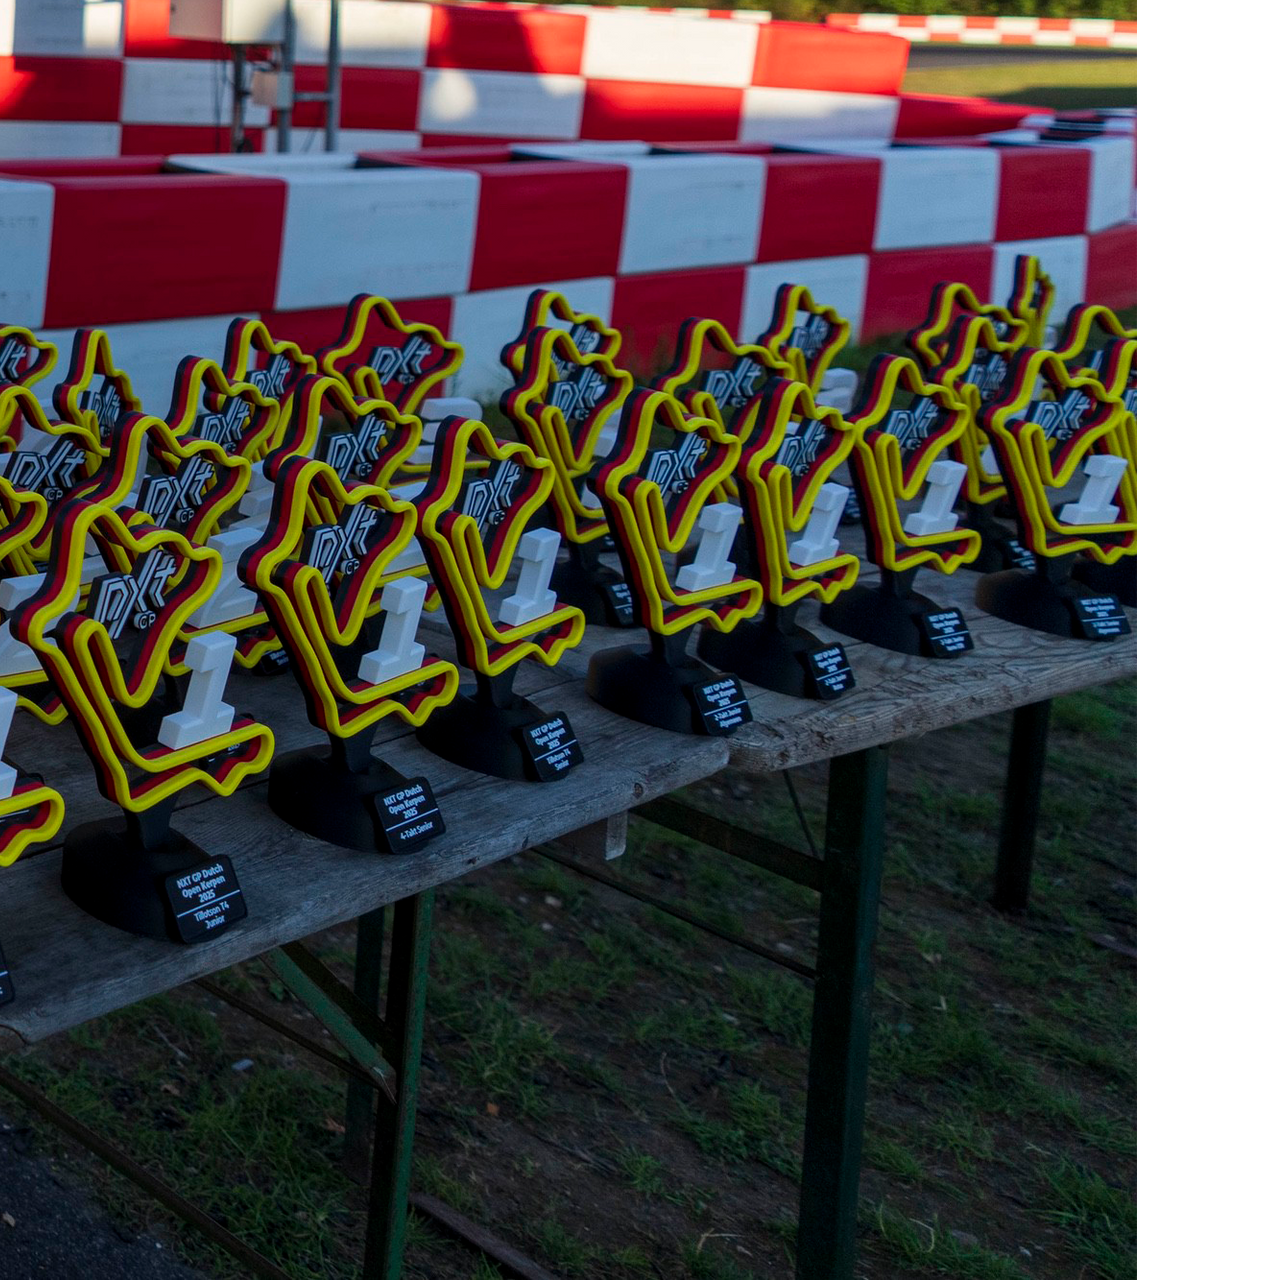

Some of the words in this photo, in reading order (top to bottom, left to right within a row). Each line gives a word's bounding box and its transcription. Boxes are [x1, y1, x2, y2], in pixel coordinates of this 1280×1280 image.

[790, 482, 850, 567] 1
[904, 460, 968, 536] 1
[1059, 454, 1128, 526] 1
[498, 527, 562, 626] 1
[675, 502, 744, 592] 1
[357, 576, 429, 685] 1
[157, 630, 238, 750] 1
